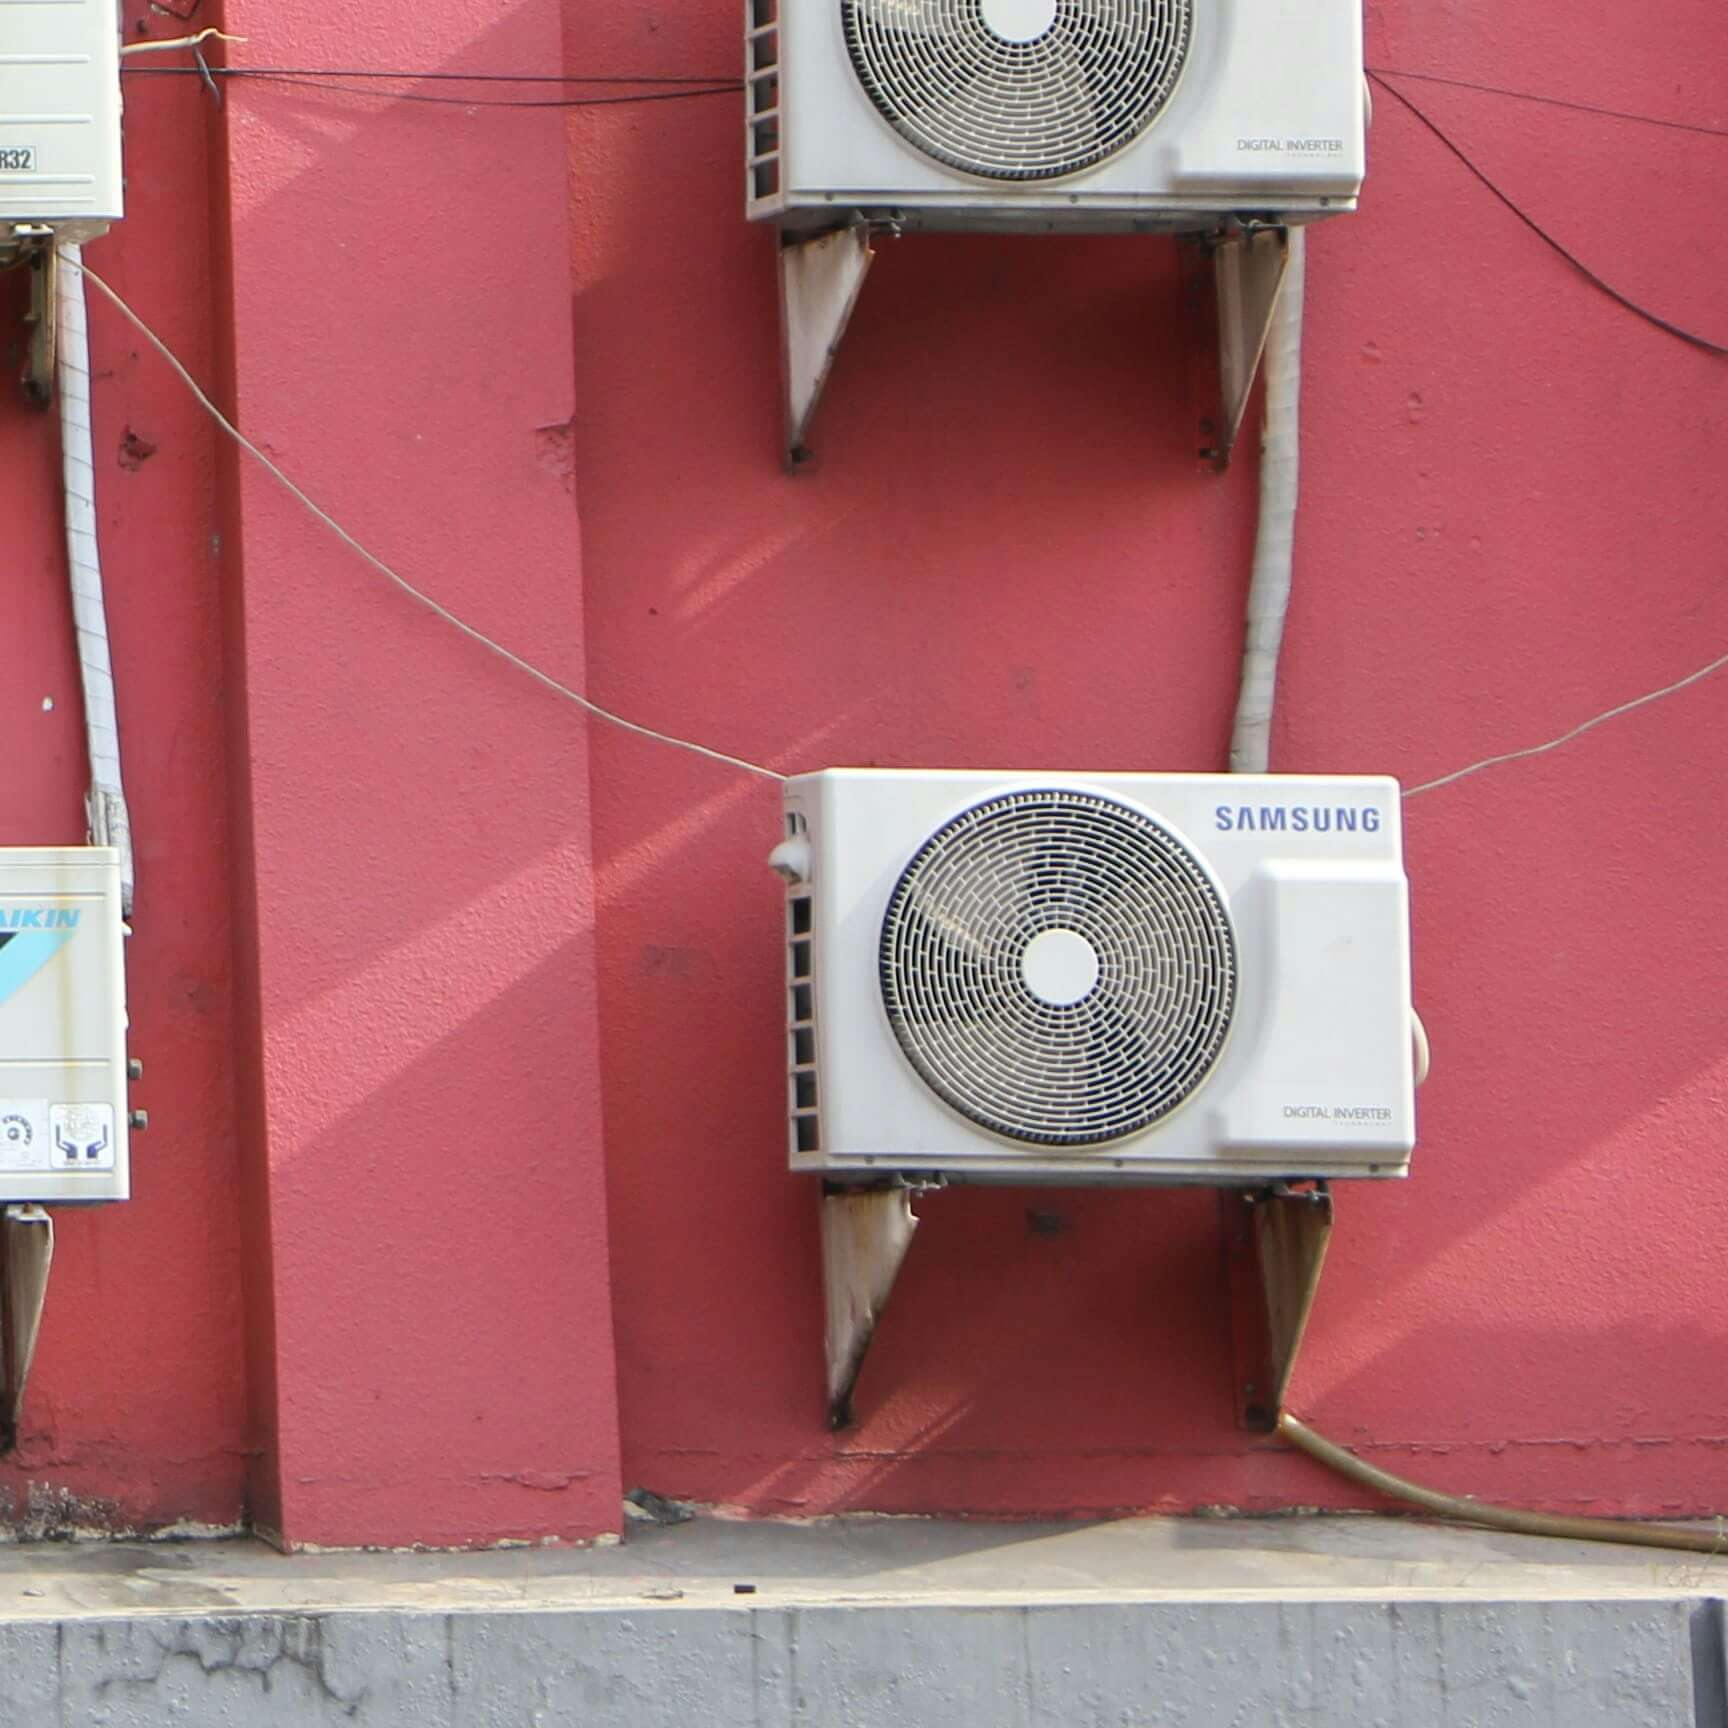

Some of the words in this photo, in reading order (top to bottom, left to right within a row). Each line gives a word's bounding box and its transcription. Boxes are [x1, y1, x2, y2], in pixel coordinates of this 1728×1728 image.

[1236, 138, 1284, 152] DIGITAL
[1286, 139, 1344, 152] INVERTER
[1215, 805, 1380, 833] SAMSUNG
[1283, 1105, 1331, 1119] DIGITAL
[1333, 1106, 1392, 1120] INVERTER
